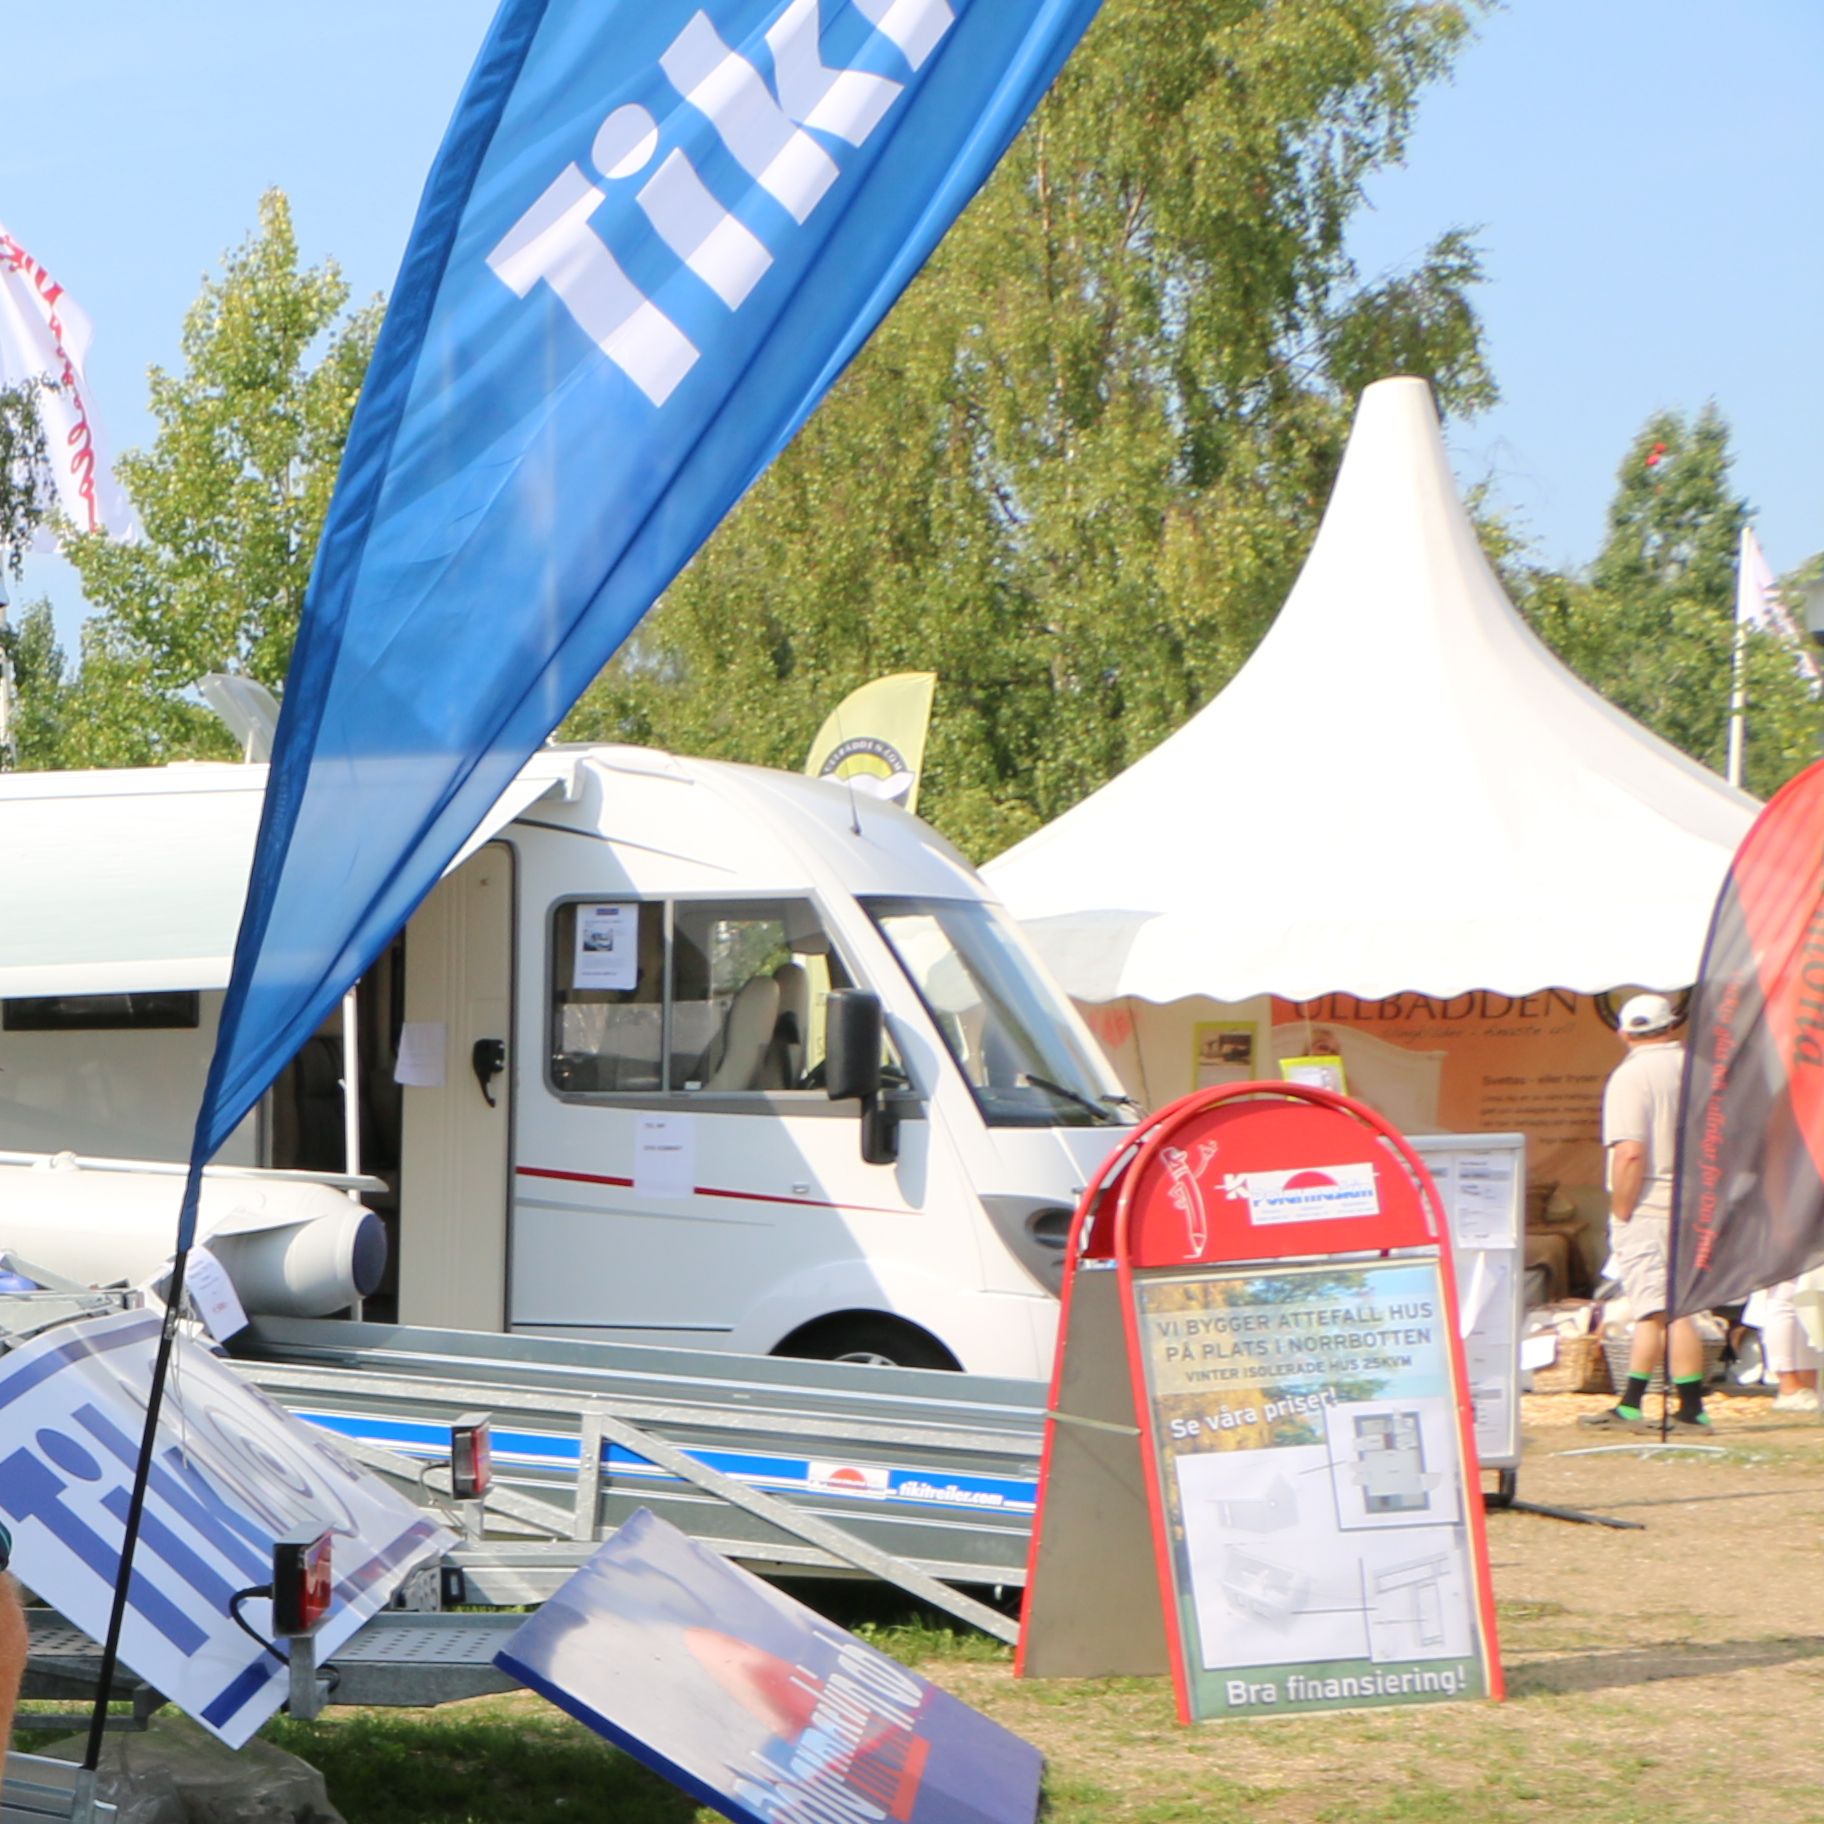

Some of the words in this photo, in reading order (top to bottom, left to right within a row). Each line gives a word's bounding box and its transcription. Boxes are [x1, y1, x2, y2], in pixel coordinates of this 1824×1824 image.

[1157, 1320, 1180, 1337] VI
[1186, 1313, 1270, 1336] BYGGER
[1278, 1306, 1383, 1330] ATTEFALL
[1390, 1302, 1434, 1321] HUS
[1166, 1340, 1196, 1363] PÅ
[1202, 1338, 1270, 1361] PLATS
[1275, 1339, 1283, 1355] I
[1287, 1328, 1432, 1354] NORRBOTTEN
[1185, 1367, 1240, 1383] VINTER
[1243, 1360, 1327, 1379] ISOLERADE
[1329, 1358, 1360, 1372] HUS
[1170, 1416, 1201, 1440] Se
[1204, 1404, 1260, 1431] våra
[1263, 1386, 1339, 1423] priser!
[899, 1481, 1004, 1507] tikitreiler.com
[1226, 1673, 1279, 1707] Bra
[1286, 1665, 1468, 1706] finansiering!
